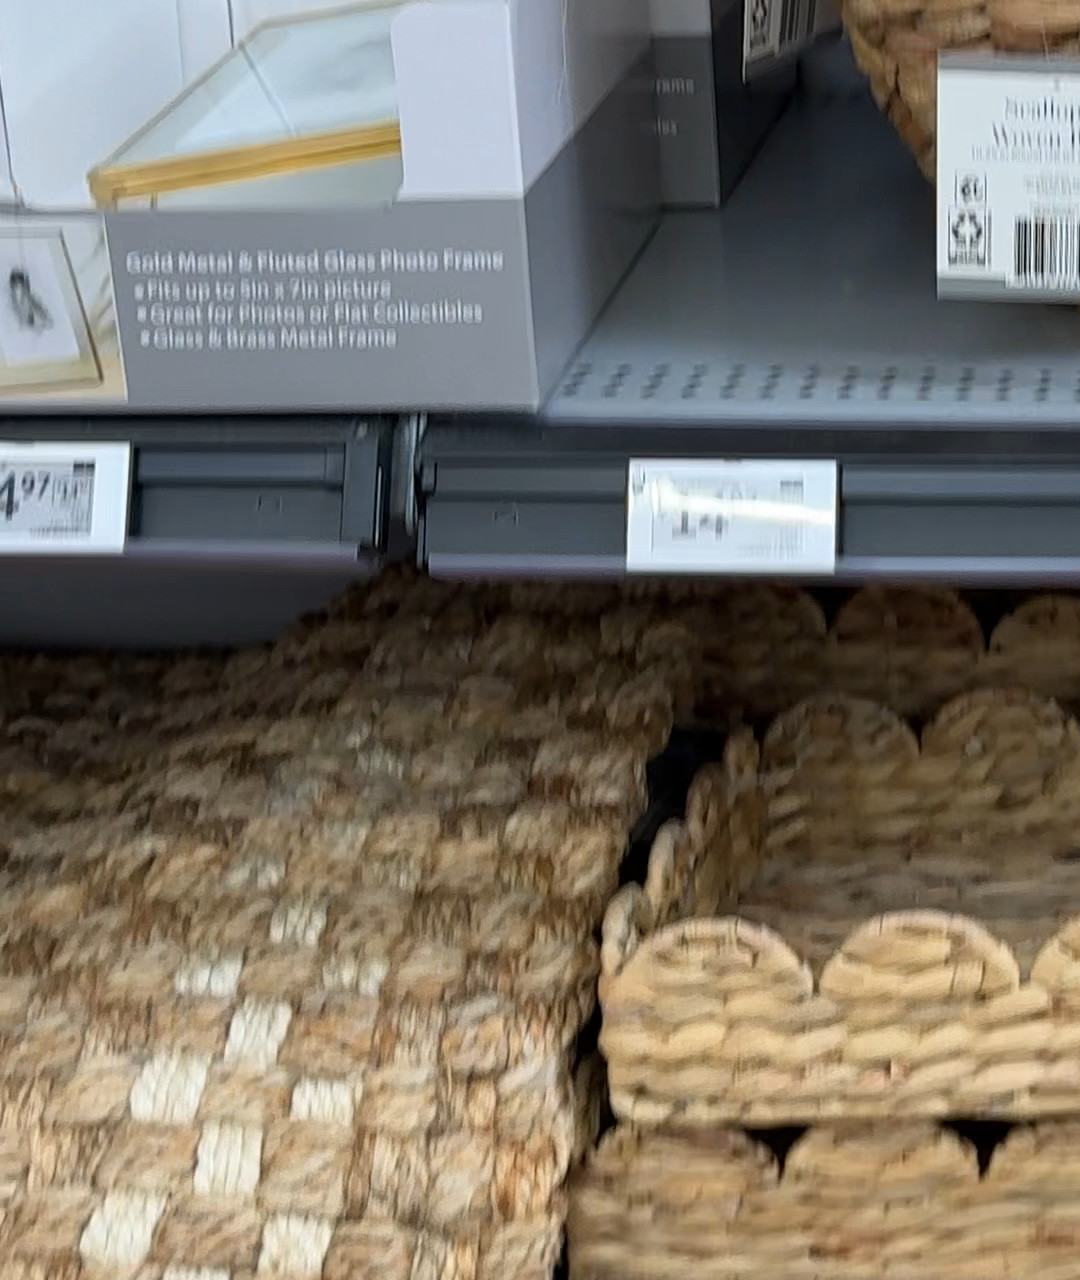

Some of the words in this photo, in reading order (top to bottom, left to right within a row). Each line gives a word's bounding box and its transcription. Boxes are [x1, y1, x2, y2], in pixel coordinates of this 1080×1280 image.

[380, 248, 439, 272] Photo
[443, 247, 504, 272] Frame
[323, 277, 392, 303] picture
[239, 301, 305, 326] Photos
[373, 298, 484, 325] Collectibles
[338, 324, 398, 349] Frame
